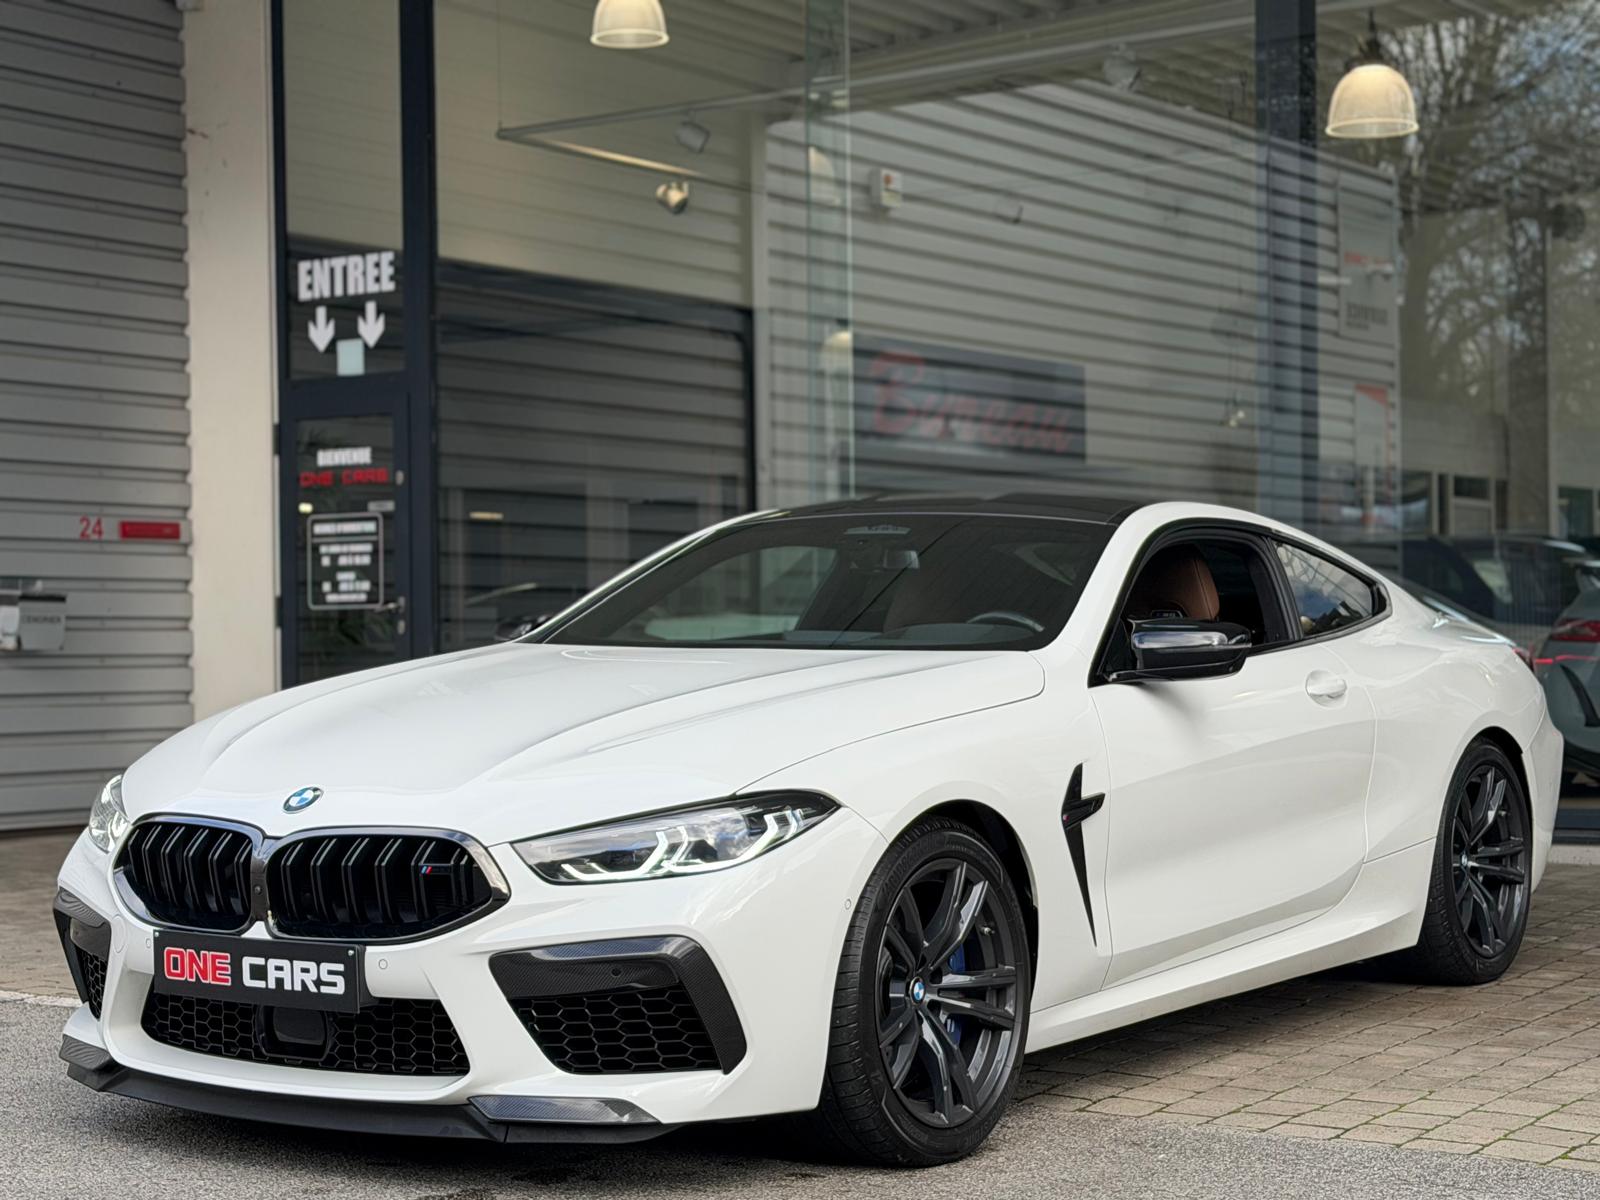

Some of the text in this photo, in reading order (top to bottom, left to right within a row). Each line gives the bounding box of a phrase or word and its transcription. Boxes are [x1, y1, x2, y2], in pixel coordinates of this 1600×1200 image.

[298, 251, 396, 302] ENTREE
[79, 516, 104, 540] 24
[163, 947, 346, 995] ONE CARS
